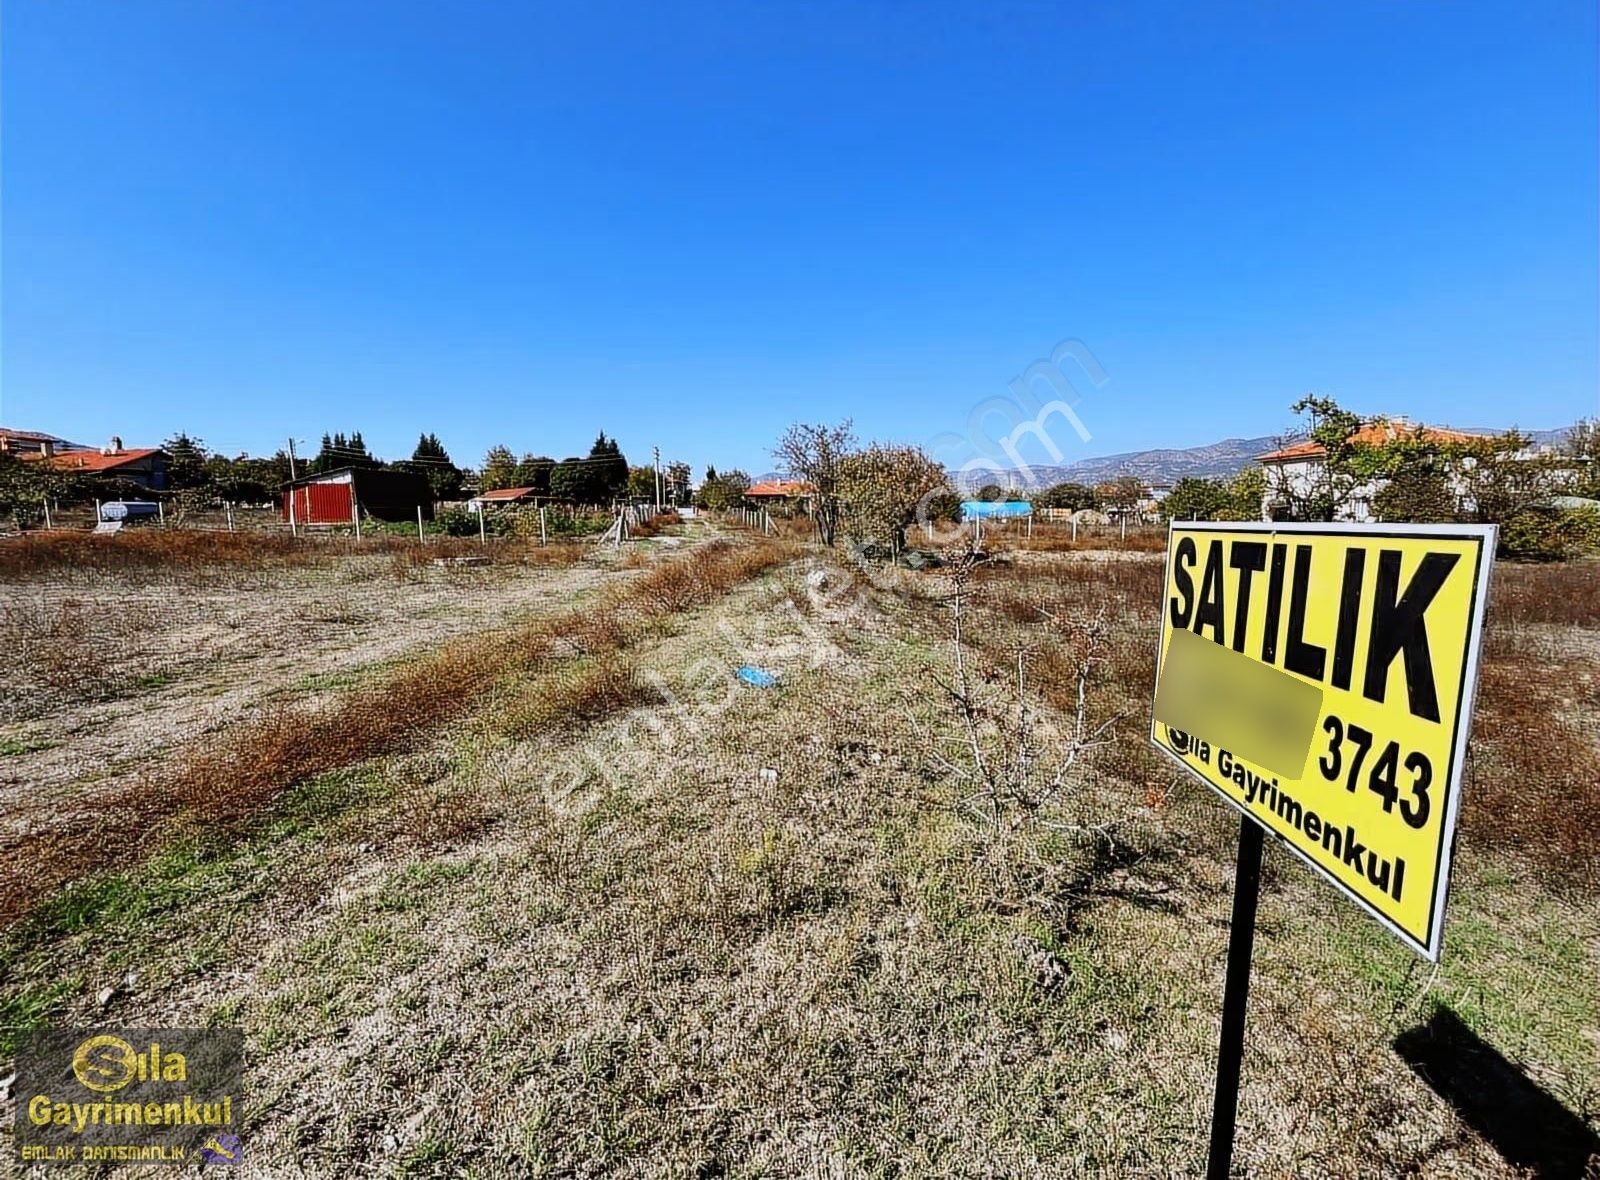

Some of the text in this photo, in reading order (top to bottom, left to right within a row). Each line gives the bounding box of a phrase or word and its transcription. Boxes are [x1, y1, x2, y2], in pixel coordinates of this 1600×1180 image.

[1170, 536, 1462, 724] SATILIK
[1218, 749, 1406, 903] Gayrimenkul
[1318, 715, 1433, 829] 3743
